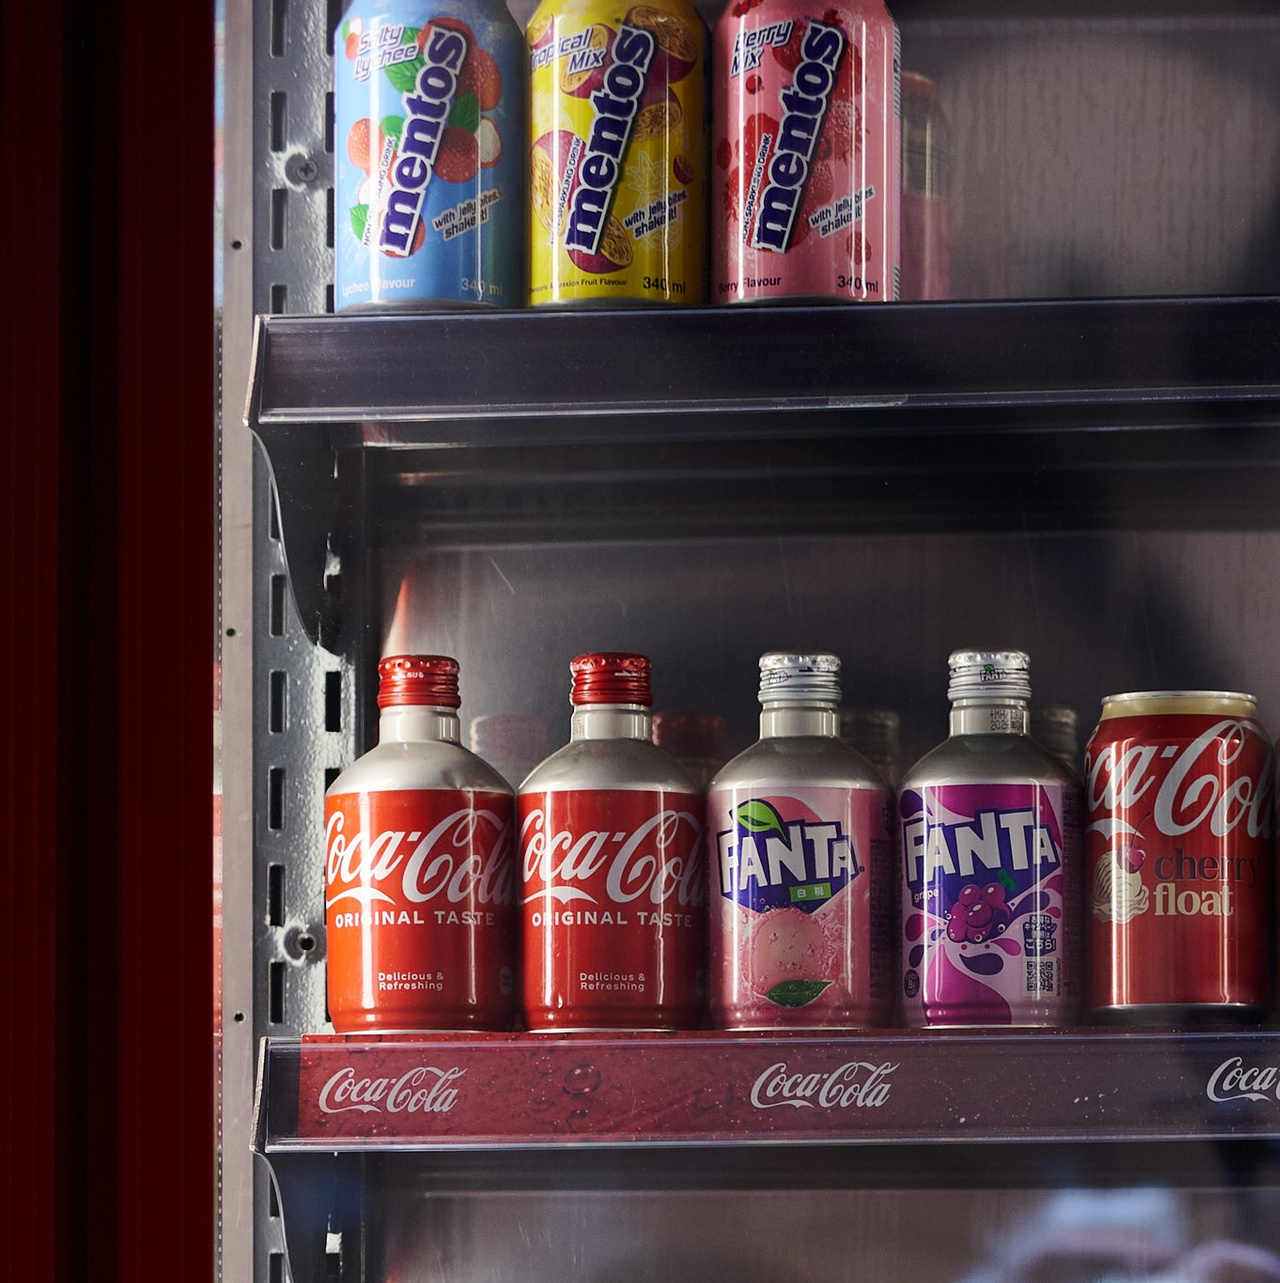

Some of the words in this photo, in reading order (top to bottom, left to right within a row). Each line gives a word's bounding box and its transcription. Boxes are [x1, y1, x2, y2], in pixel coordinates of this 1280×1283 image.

[569, 50, 605, 74] Mix
[379, 26, 467, 257] mentos
[565, 27, 654, 254] mentos
[752, 23, 845, 254] mentos
[434, 208, 456, 229] with
[457, 200, 479, 224] jelly
[625, 208, 647, 229] with
[648, 199, 668, 220] jelly
[811, 206, 832, 226] with
[821, 212, 853, 236] shake
[445, 216, 476, 239] shake
[461, 278, 485, 293] 340
[489, 284, 502, 295] ml
[581, 277, 598, 287] Fruit
[600, 277, 627, 287] Flavour
[643, 276, 667, 290] 340
[672, 281, 686, 294] ml
[907, 812, 1057, 882] FANTA
[719, 824, 857, 895] FANTA
[1155, 849, 1260, 884] cherry
[914, 888, 938, 903] grape
[1154, 883, 1233, 916] float
[335, 912, 424, 929] ORIGINAL
[435, 911, 495, 929] TASTE
[532, 912, 627, 928] ORIGINAL
[637, 912, 692, 929] TASTE
[378, 972, 432, 982] Delicious
[437, 972, 444, 982] &
[379, 981, 444, 993] Refreshing
[580, 972, 634, 982] Delicious
[638, 972, 646, 982] &
[580, 982, 645, 993] Refreshing
[320, 1067, 467, 1114] Coca-Cola
[751, 1063, 900, 1109] Coca-Cola
